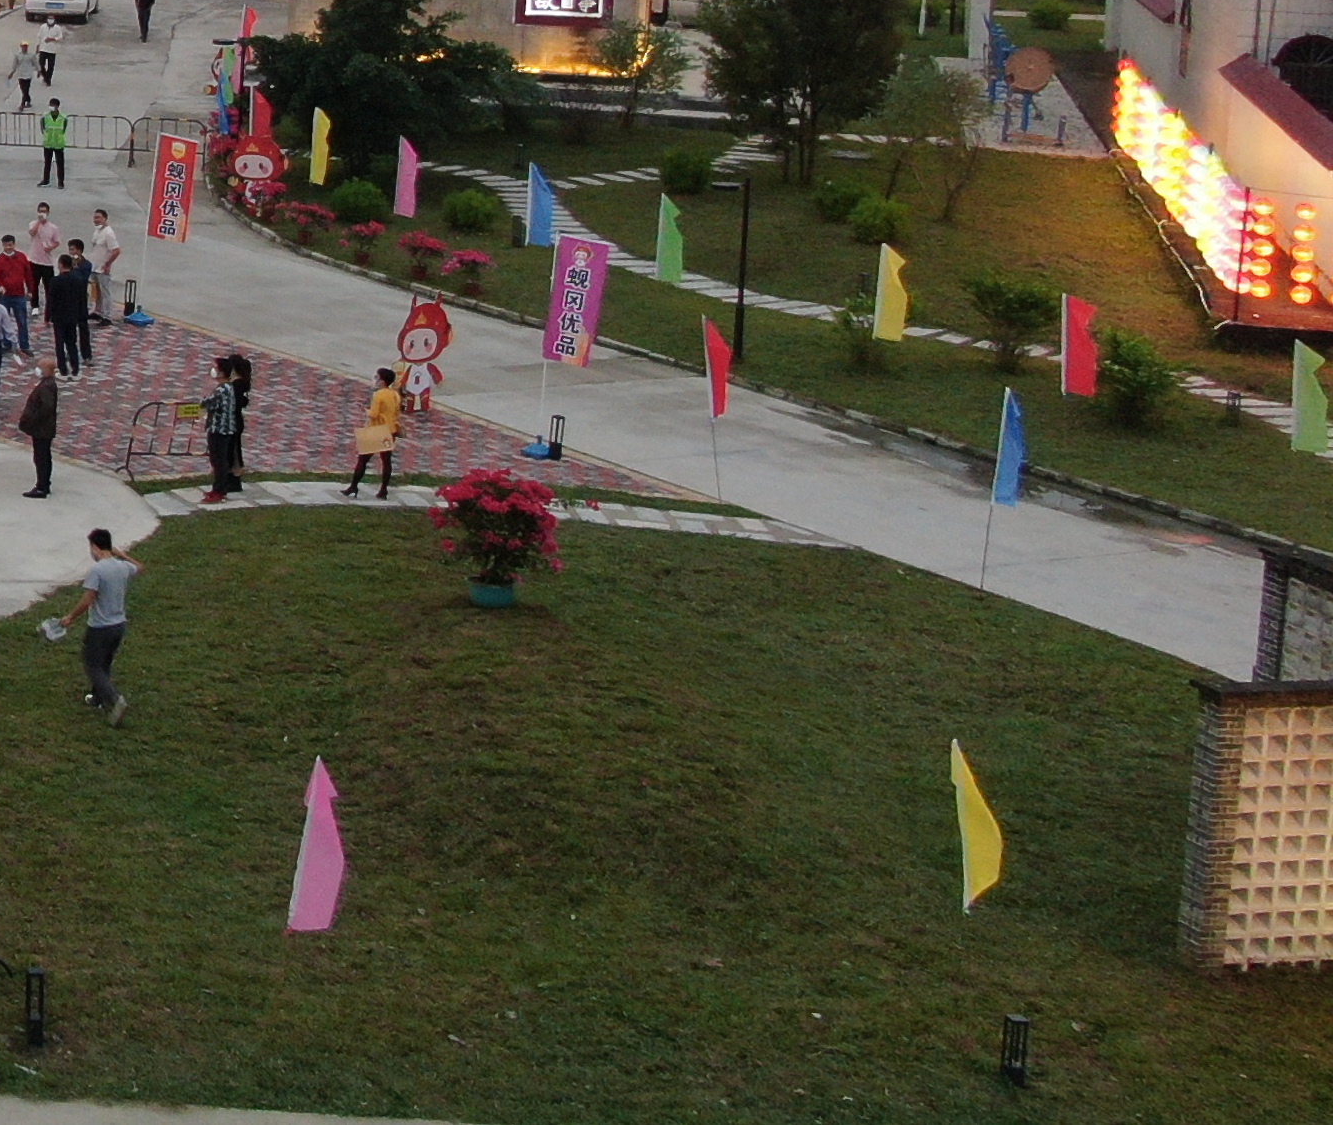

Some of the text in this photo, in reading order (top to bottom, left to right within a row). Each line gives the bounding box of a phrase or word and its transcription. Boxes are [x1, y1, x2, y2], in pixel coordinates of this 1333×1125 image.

[158, 160, 186, 236] 蚬冈优品
[554, 266, 590, 357] 蚬冈优品
